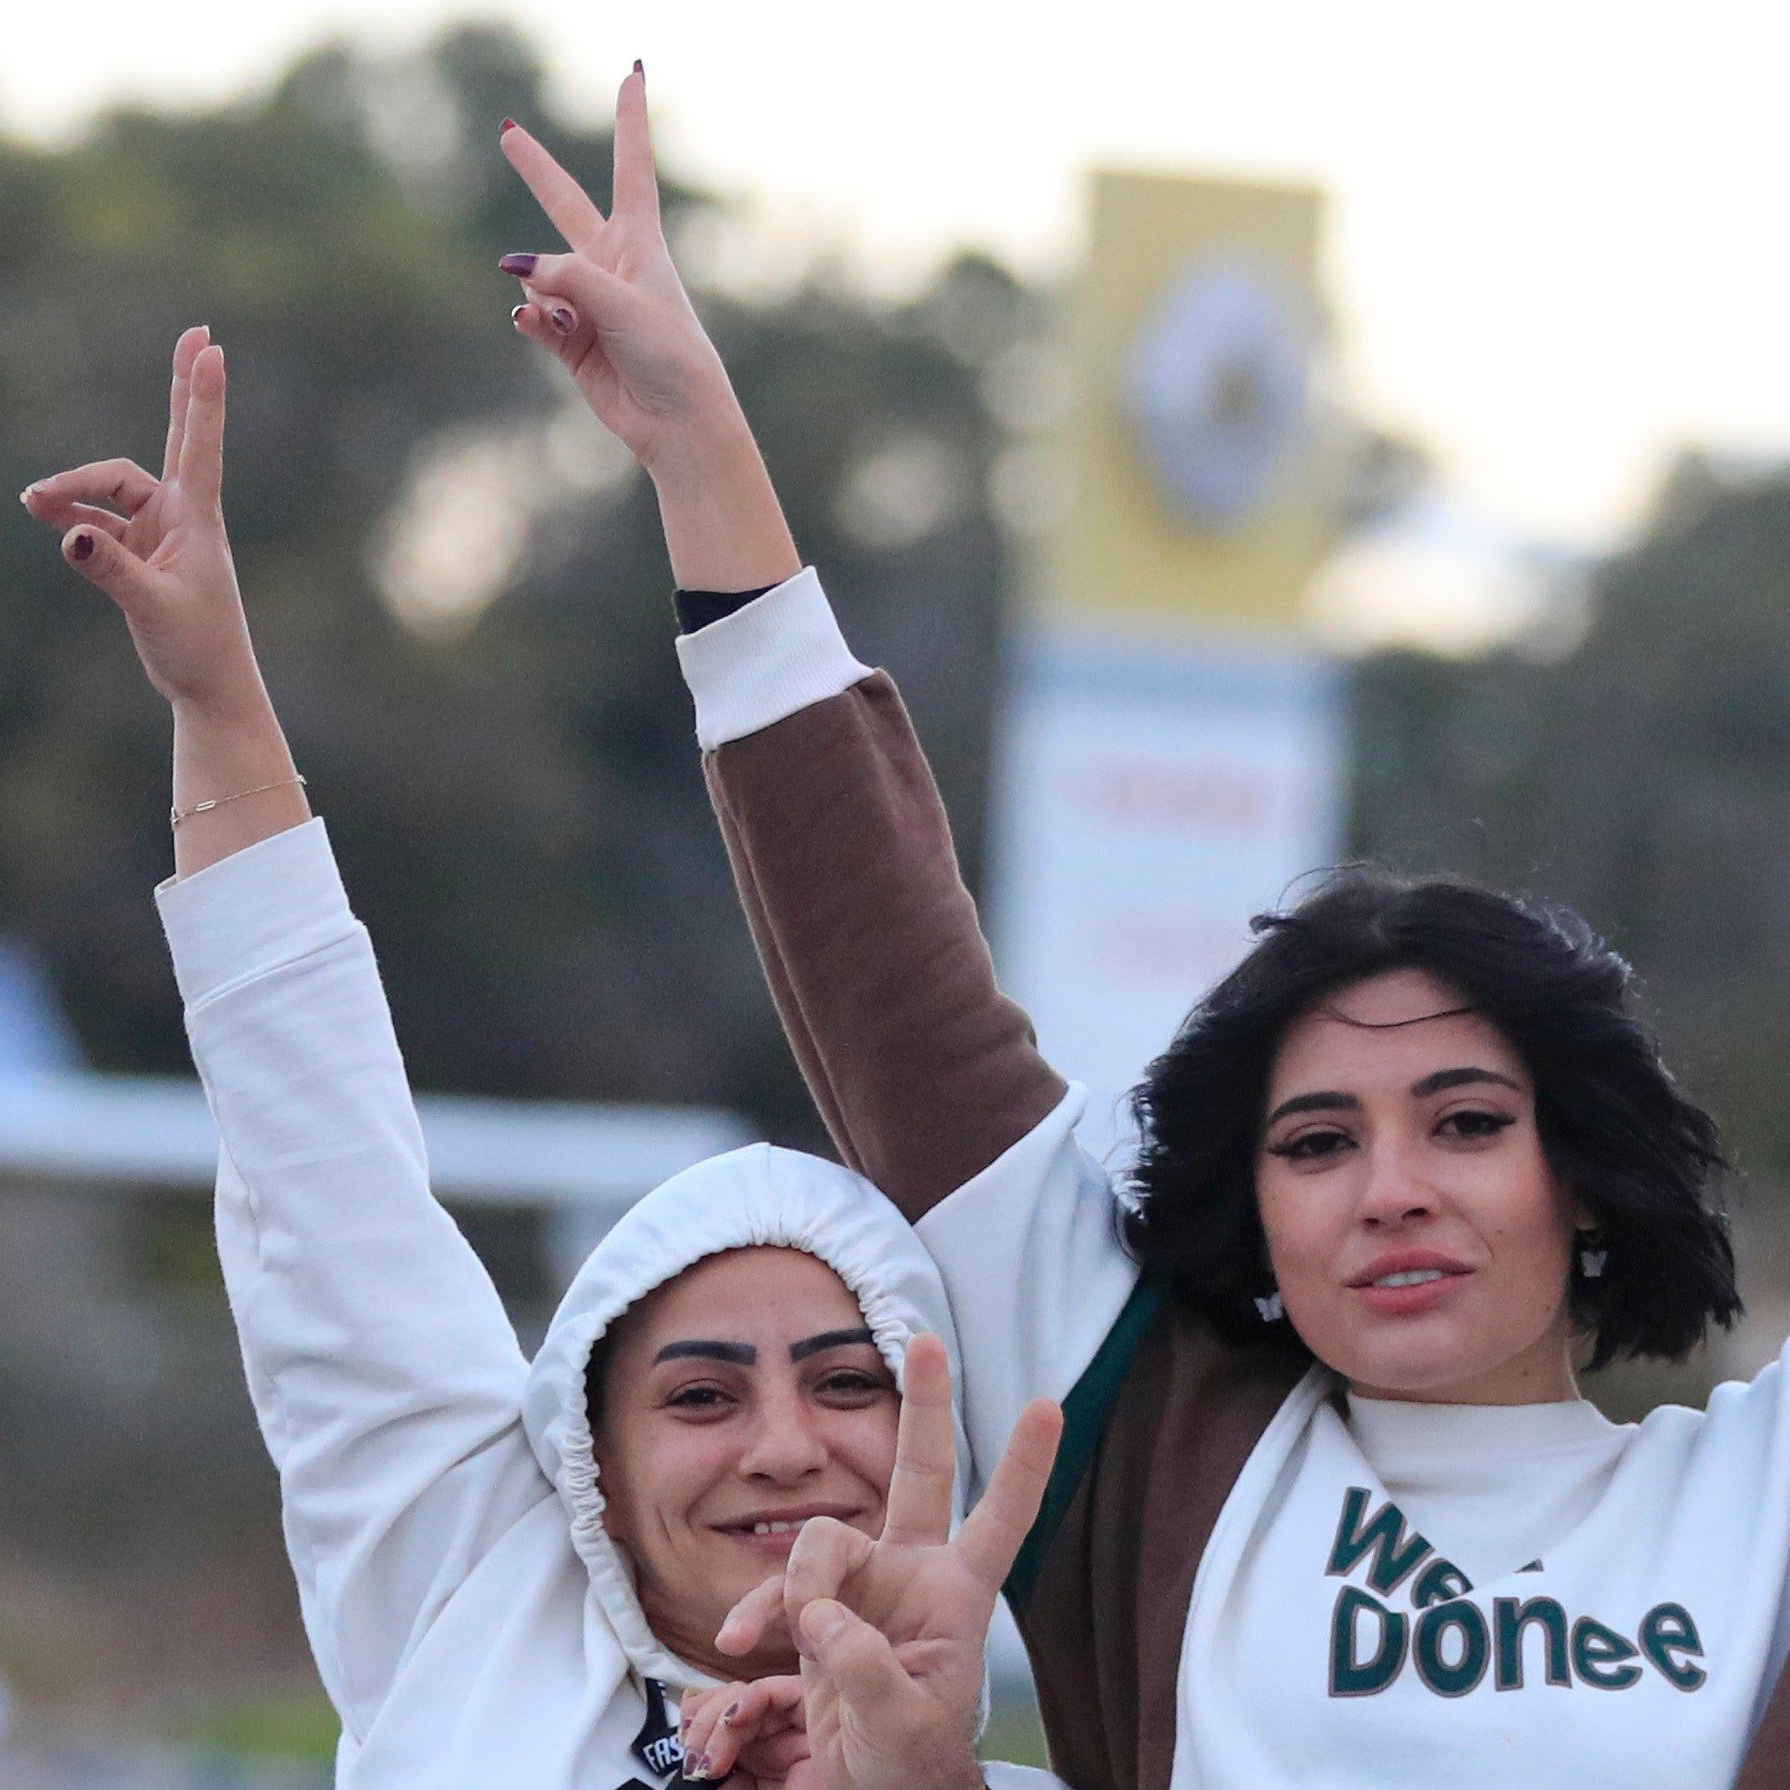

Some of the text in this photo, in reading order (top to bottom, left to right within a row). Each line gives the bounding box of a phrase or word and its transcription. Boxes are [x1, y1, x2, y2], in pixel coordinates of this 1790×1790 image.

[1324, 1485, 1544, 1610] We
[1328, 1584, 1708, 1699] Donee
[642, 1734, 686, 1773] FAS
